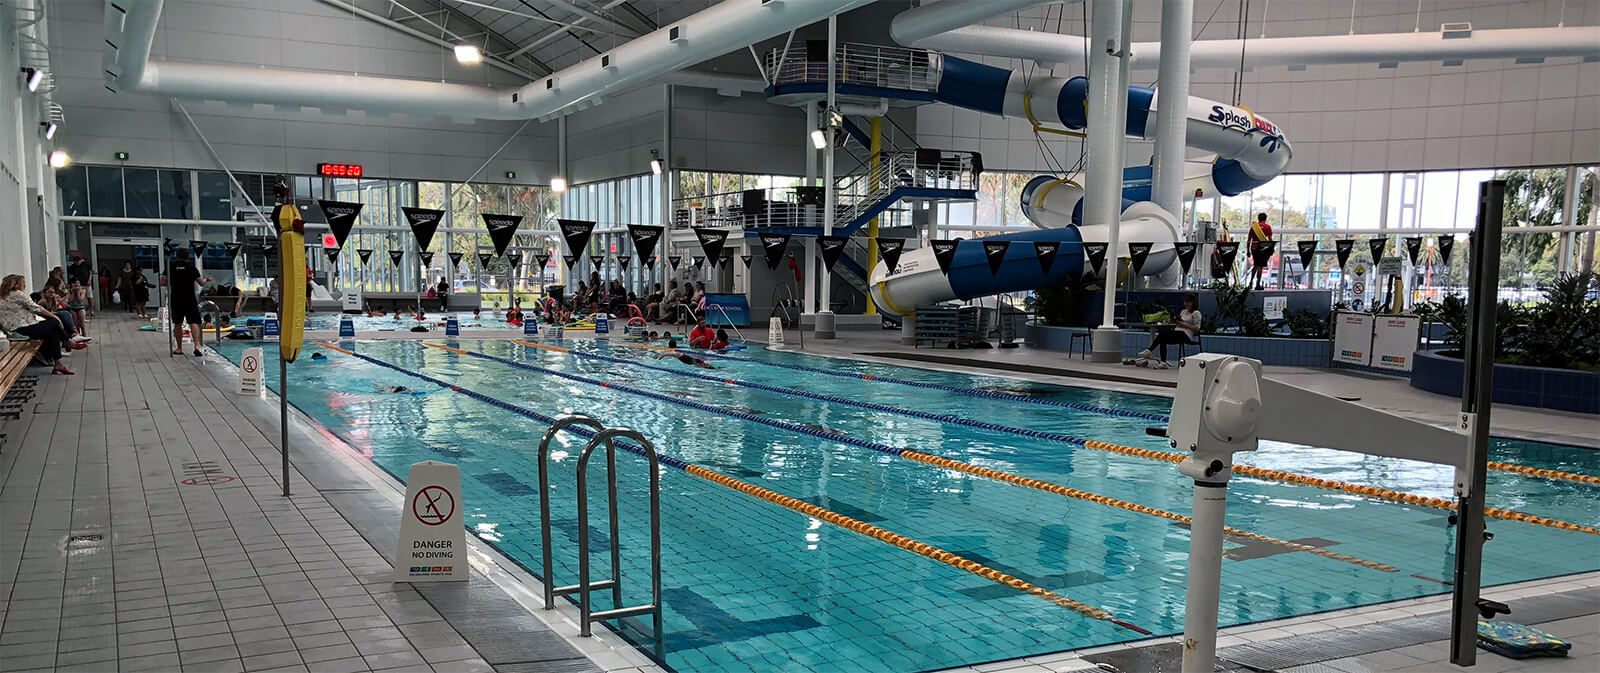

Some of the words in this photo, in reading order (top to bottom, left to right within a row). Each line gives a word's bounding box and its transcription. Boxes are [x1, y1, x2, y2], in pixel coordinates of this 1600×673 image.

[1208, 106, 1251, 128] Splash
[327, 206, 355, 214] speedo
[410, 213, 437, 221] speedo
[489, 219, 514, 227] speedo
[701, 233, 723, 241] speedo
[413, 540, 453, 549] DANGER
[412, 551, 425, 559] NO
[426, 551, 453, 559] DIVING
